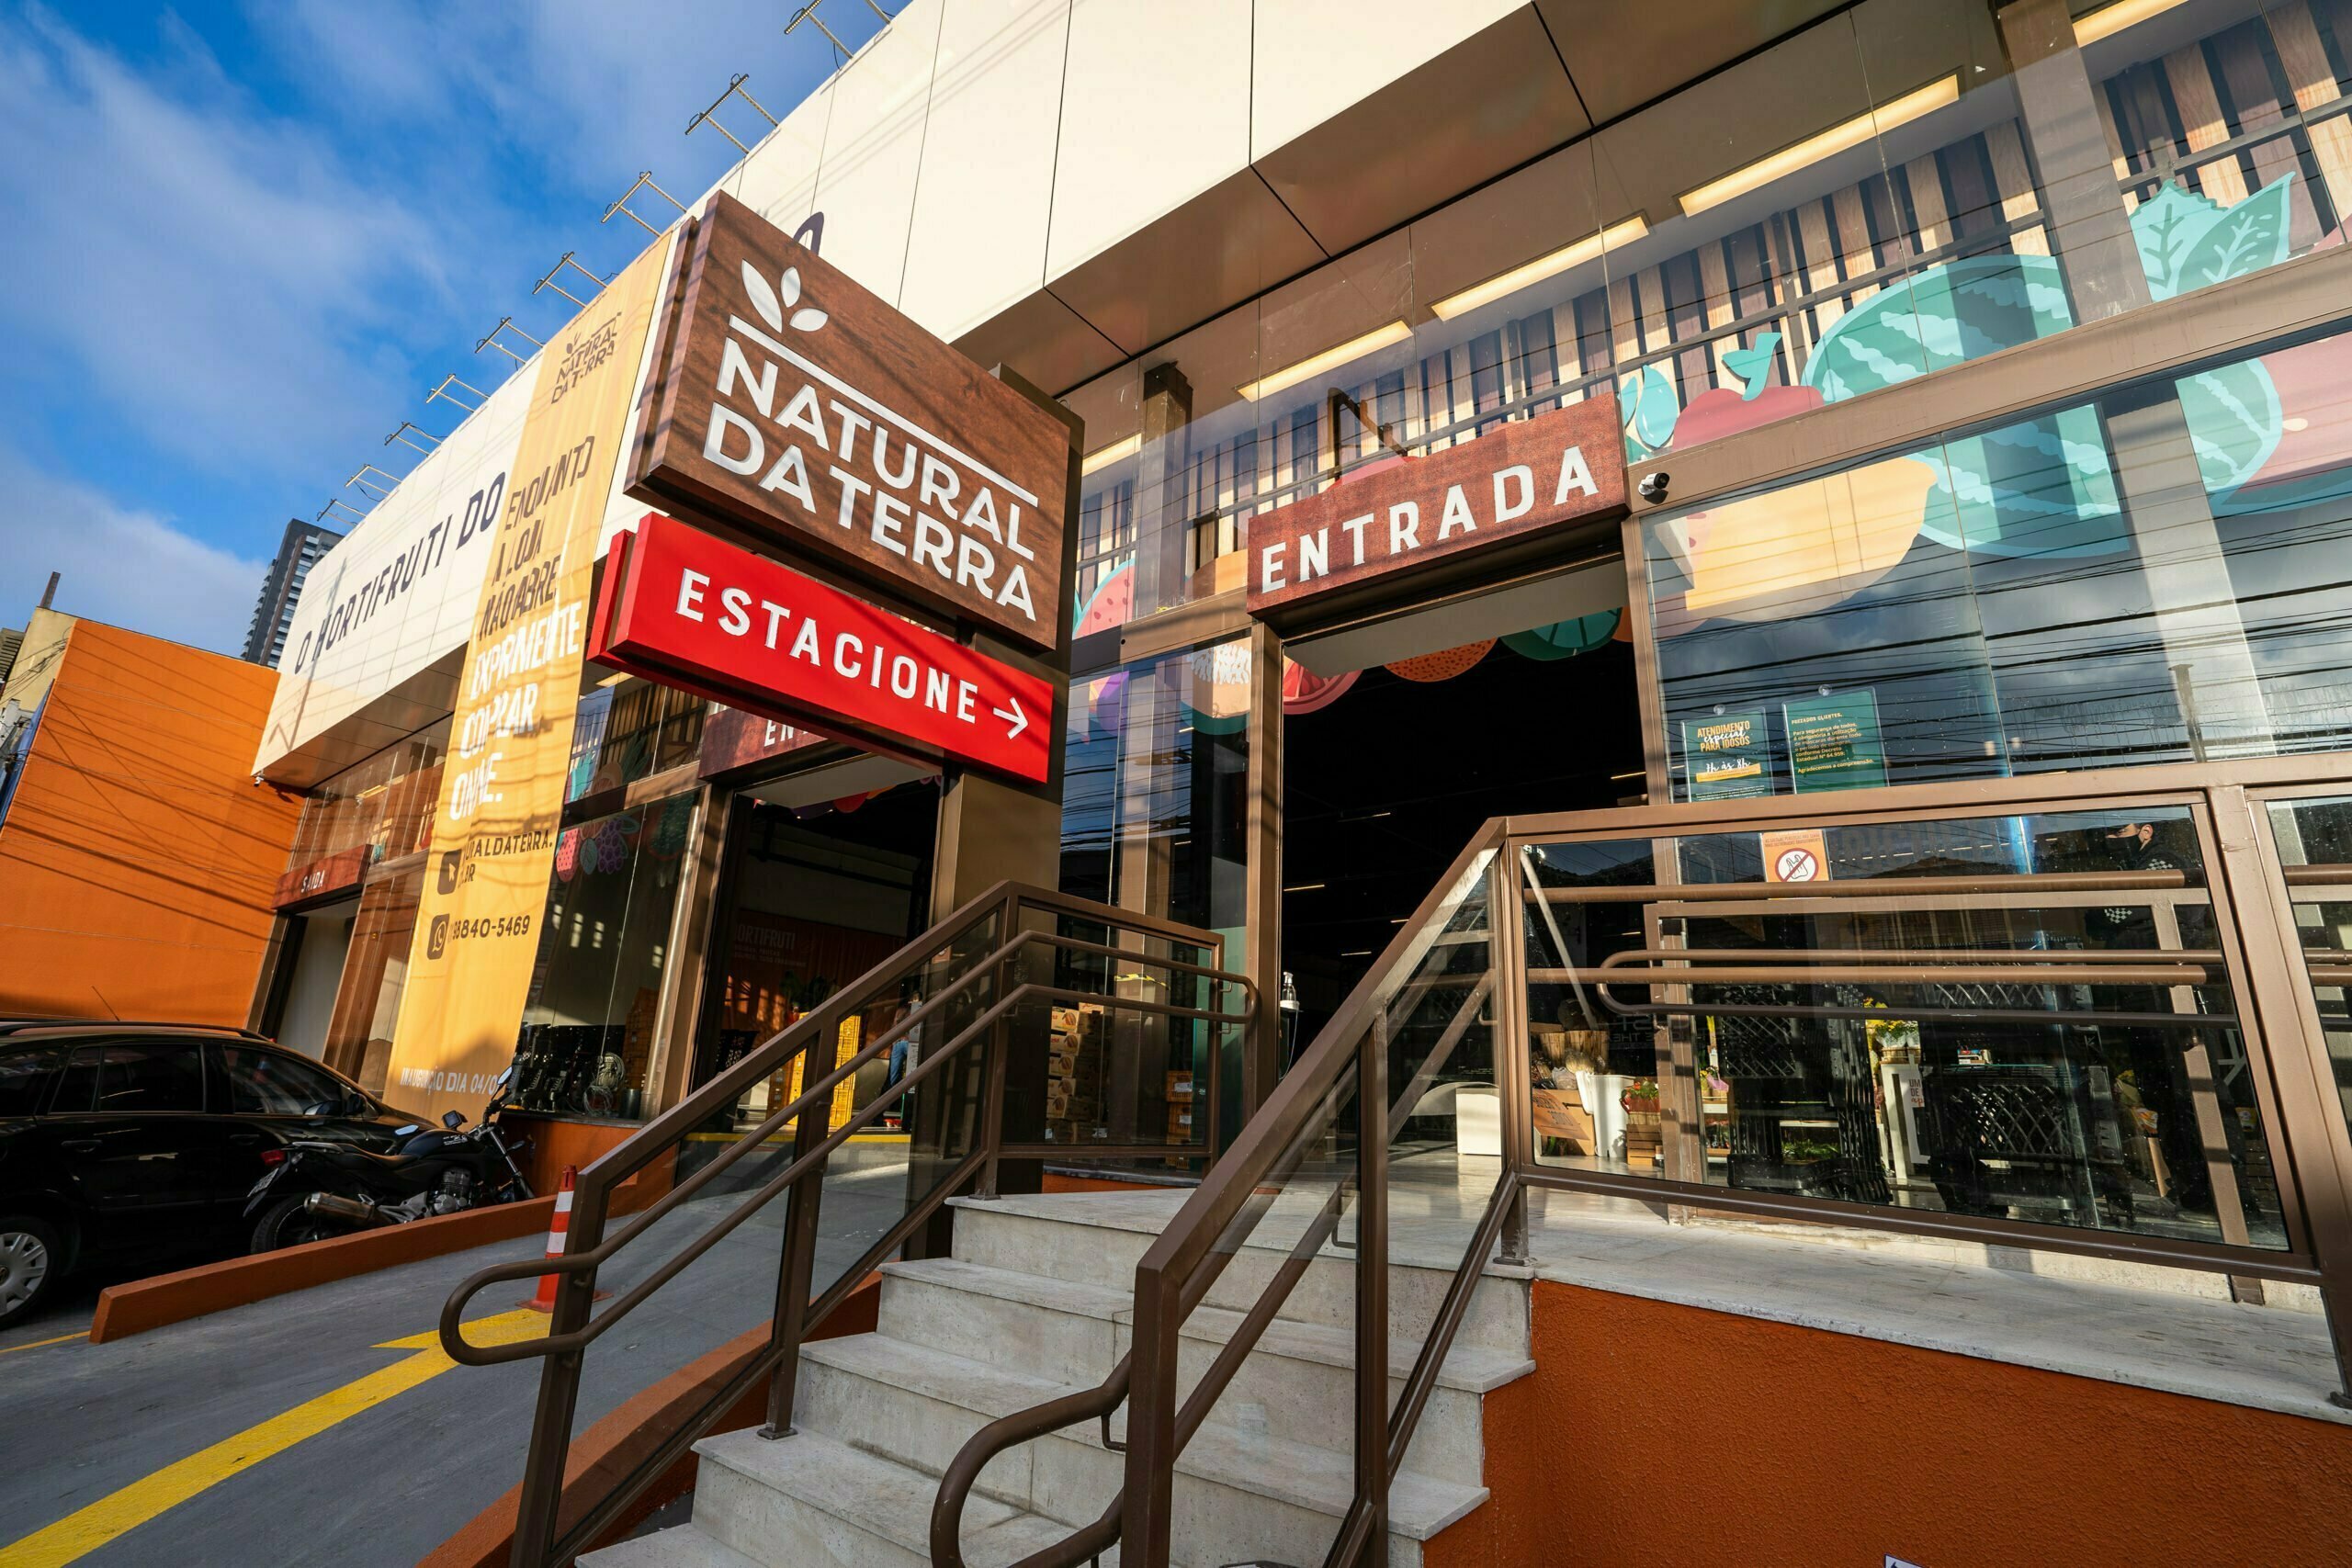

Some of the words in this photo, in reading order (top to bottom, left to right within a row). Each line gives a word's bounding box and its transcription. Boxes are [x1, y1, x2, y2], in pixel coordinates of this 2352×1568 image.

[571, 339, 615, 388] TRRA
[715, 335, 1035, 562] NATURAL
[702, 401, 817, 514] DA
[829, 464, 1036, 623] TERRA
[1261, 445, 1599, 594] ENTRADA
[294, 630, 312, 675] O
[311, 513, 453, 662] HORTIFRUTI
[456, 471, 506, 551] DO
[675, 567, 979, 726] ESTACIONE
[1697, 720, 1750, 739] ATENDIMENTO
[1700, 740, 1721, 752] PARA
[1723, 736, 1750, 749] IDOSOS
[1703, 728, 1746, 744] especial
[734, 924, 797, 950] ORTIFRUTI
[446, 1072, 468, 1093] DIA
